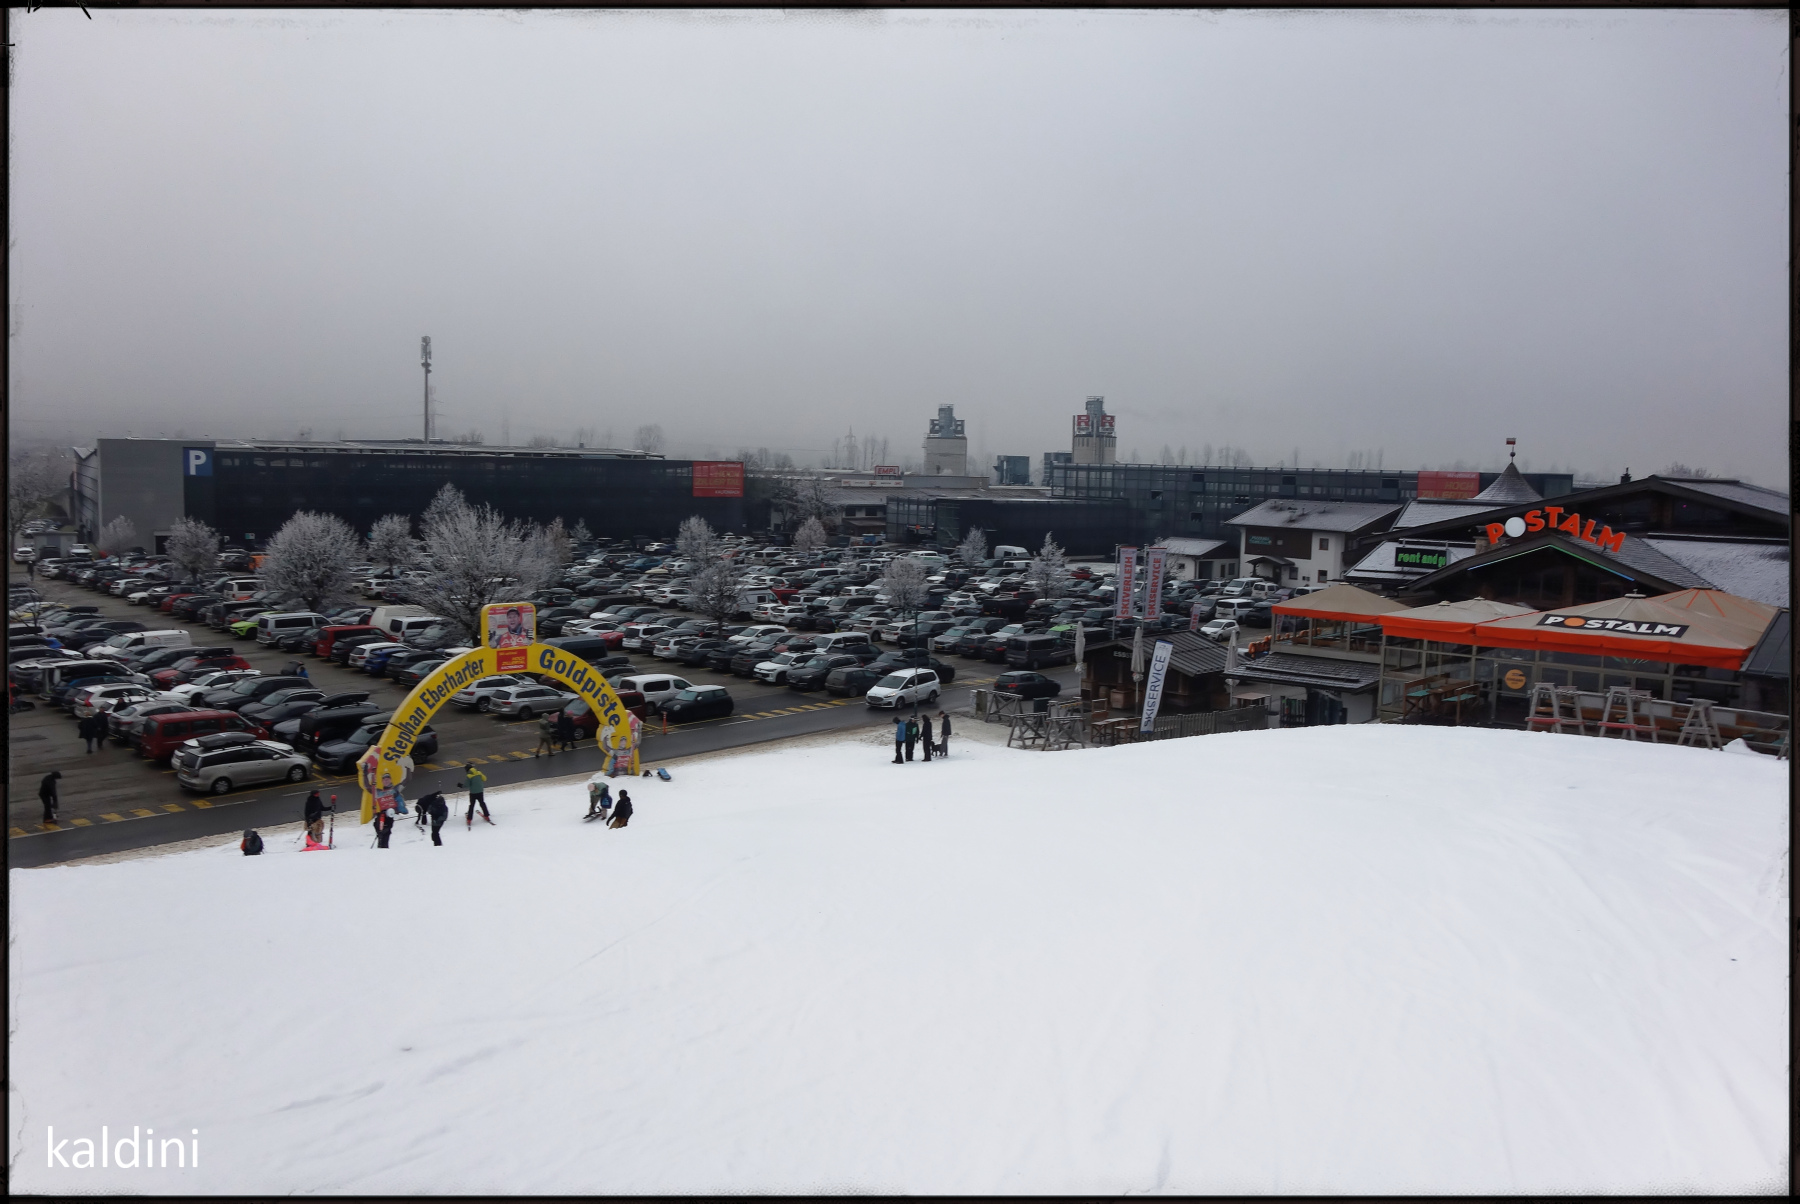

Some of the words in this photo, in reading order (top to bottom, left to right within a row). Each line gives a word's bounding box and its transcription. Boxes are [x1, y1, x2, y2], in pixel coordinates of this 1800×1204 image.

[189, 449, 207, 475] P
[1444, 481, 1475, 490] HOCH
[1485, 506, 1627, 553] POSTALM
[1397, 552, 1421, 563] rent
[1421, 553, 1438, 565] and
[1121, 556, 1133, 615] SKIVERLEIH
[1147, 557, 1162, 616] SKISERVICE
[1545, 616, 1681, 635] POSTALM
[383, 706, 427, 763] Stephan
[419, 657, 485, 710] Eberharter
[539, 648, 621, 727] Goldpiste
[1144, 653, 1166, 728] SKISERVICE
